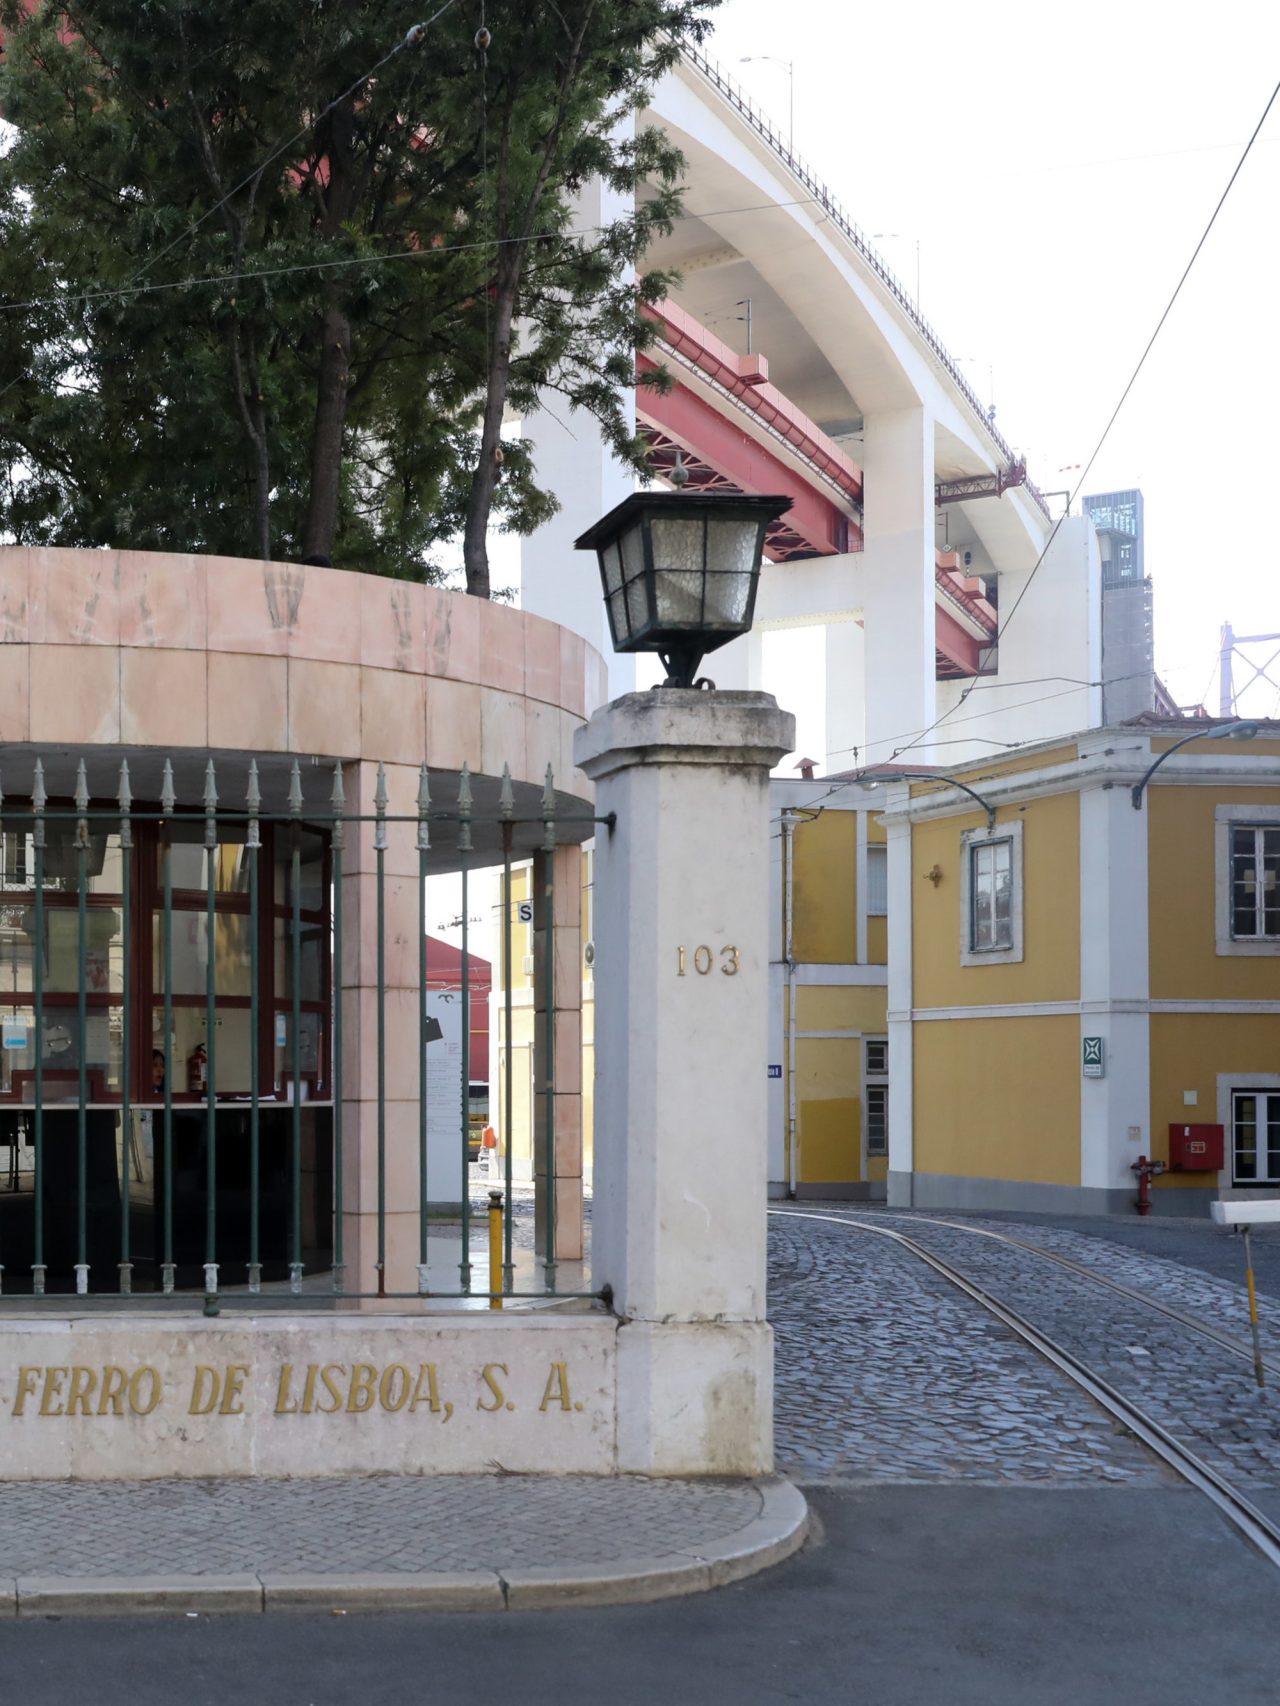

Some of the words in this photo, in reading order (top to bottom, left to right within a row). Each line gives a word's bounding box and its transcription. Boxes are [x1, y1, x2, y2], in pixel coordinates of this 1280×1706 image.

[520, 904, 532, 921] S
[677, 944, 740, 977] 103
[11, 1365, 162, 1417] FERRO
[187, 1364, 250, 1416] DE
[273, 1361, 455, 1423] LISBOA,
[476, 1361, 516, 1412] S.
[538, 1361, 585, 1412] A.
